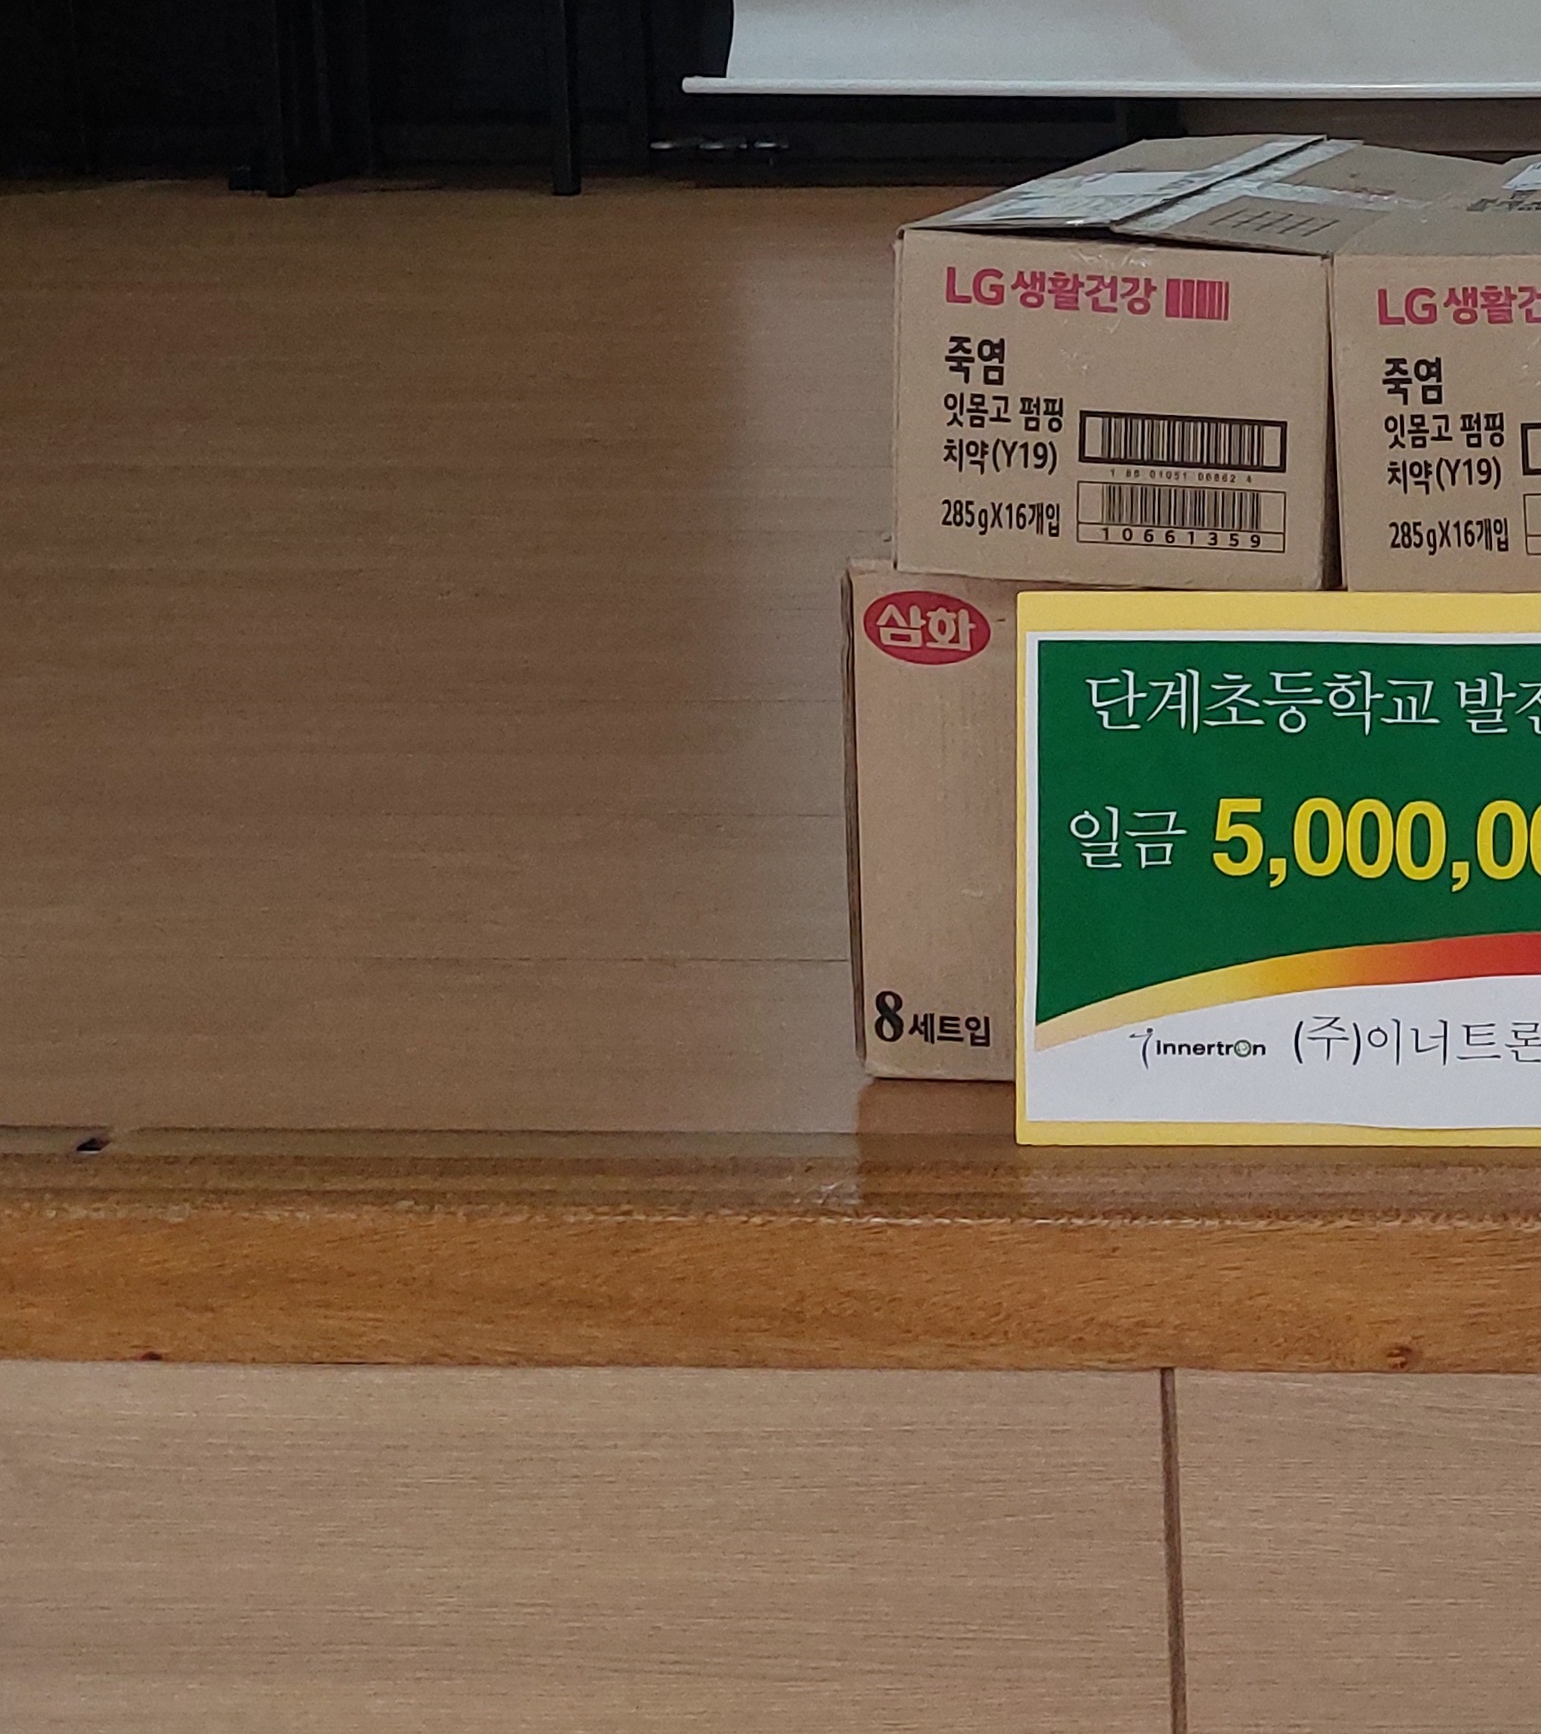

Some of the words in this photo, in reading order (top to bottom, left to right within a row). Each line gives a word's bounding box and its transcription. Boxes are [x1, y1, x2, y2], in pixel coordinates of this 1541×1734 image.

[943, 335, 1007, 387] 죽염
[1381, 356, 1444, 406] 죽염
[942, 391, 1012, 430] 잇몸고
[1018, 396, 1065, 434] 펌핑
[1384, 412, 1453, 451] 잇몸고
[1459, 411, 1506, 449] 펌핑
[942, 437, 1059, 476] 치약(Y19)
[1386, 455, 1503, 496] 치약(Y19)
[940, 497, 1061, 538] 285gX16개입
[1100, 526, 1262, 549] 10661359
[1388, 517, 1510, 556] 285gX16개입
[876, 603, 975, 652] 삼화
[1085, 668, 1441, 739] 단계초등학교
[1067, 806, 1188, 870] 일금
